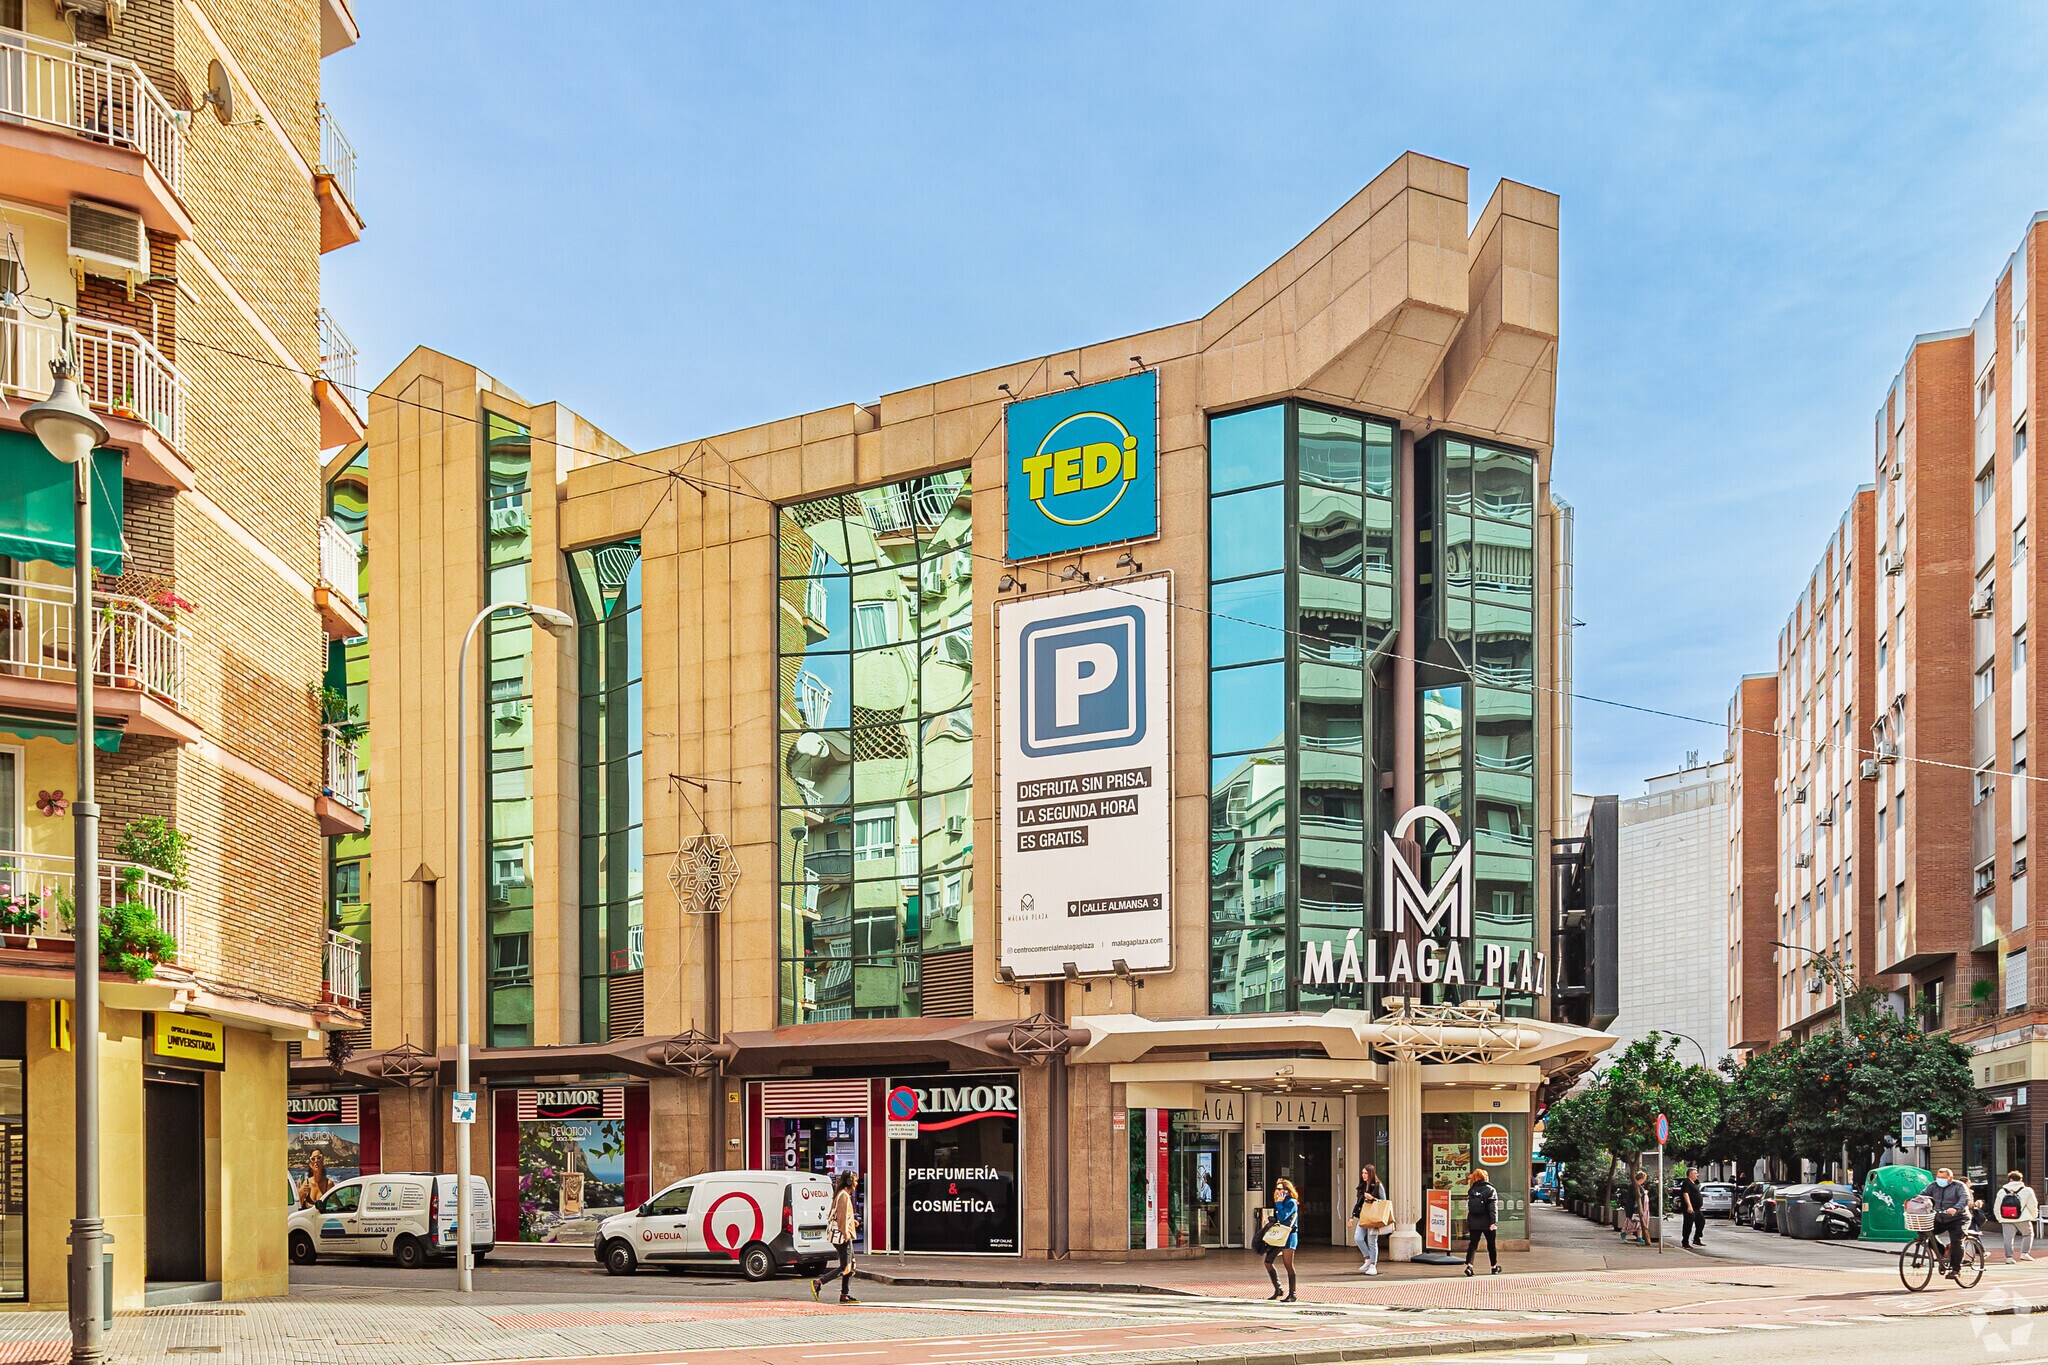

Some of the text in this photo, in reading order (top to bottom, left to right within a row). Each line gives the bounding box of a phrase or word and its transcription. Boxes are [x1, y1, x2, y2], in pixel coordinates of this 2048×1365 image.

[1022, 436, 1138, 501] TEDi
[1056, 643, 1118, 727] P
[1020, 771, 1148, 799] DISFRUTA SIN PRISA,
[1020, 798, 1137, 825] LA SEGUNDA HORA
[1020, 829, 1086, 849] ES GRATIS.
[1082, 897, 1159, 913] CALLE ALMANSA 3
[1111, 937, 1164, 948] malagaplaza.com
[1303, 928, 1547, 998] MÁLAGA PLAZ
[167, 1034, 216, 1052] UNIVERSITARIA
[287, 1098, 339, 1113] PRIMOR
[537, 1090, 600, 1106] PRIMOR
[911, 1086, 1018, 1113] RIMOR
[1276, 1100, 1330, 1123] PLAZA
[1916, 1113, 1927, 1131] P
[299, 1131, 334, 1141] DEVOTION
[551, 1126, 592, 1137] DEVOTION
[1481, 1138, 1508, 1146] BURGER
[1481, 1145, 1508, 1157] KING
[1435, 1158, 1453, 1166] King
[1440, 1164, 1467, 1172] Ahorro
[908, 1165, 999, 1180] PERFUMERÍA
[810, 1190, 829, 1198] VEOLIA
[948, 1182, 958, 1195] &
[912, 1197, 995, 1213] COSMÉTICA
[653, 1232, 682, 1240] VEOLIA
